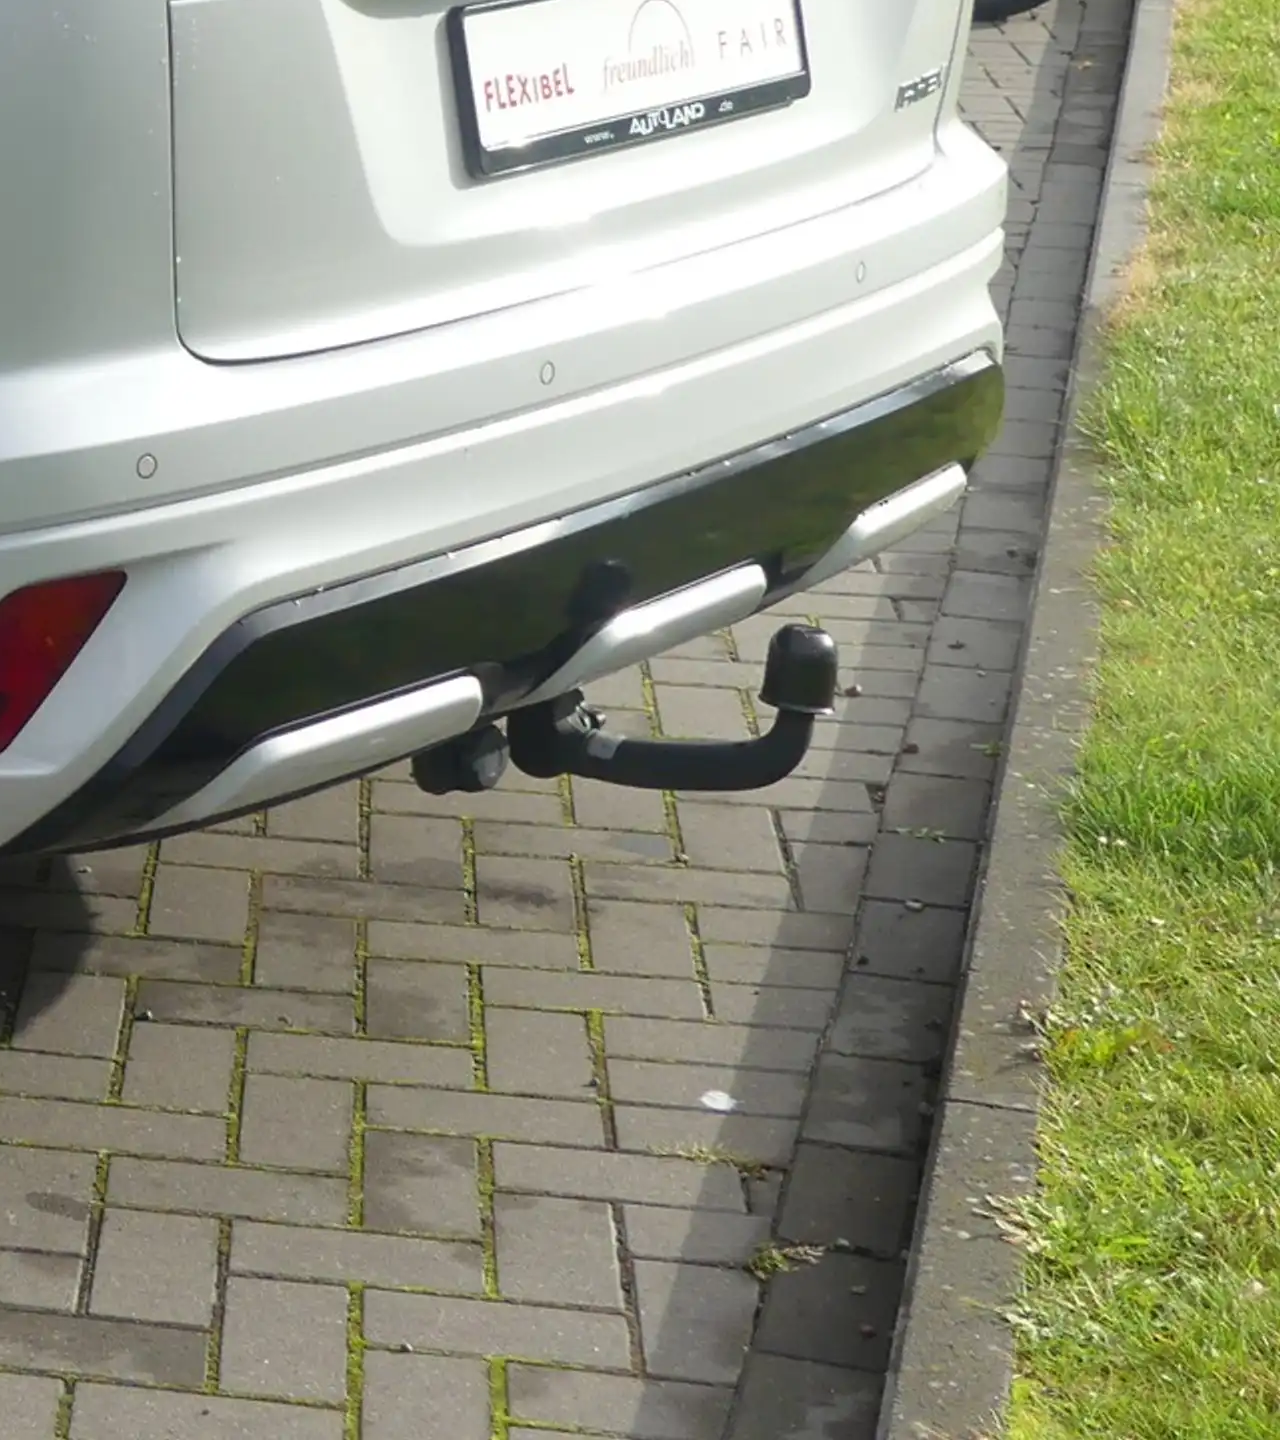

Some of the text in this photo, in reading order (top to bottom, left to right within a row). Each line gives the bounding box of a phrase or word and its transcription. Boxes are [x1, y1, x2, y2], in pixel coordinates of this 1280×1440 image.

[484, 17, 787, 112] FLEXIBEL freundlich FAIR
[629, 102, 705, 136] AUTOLAND
